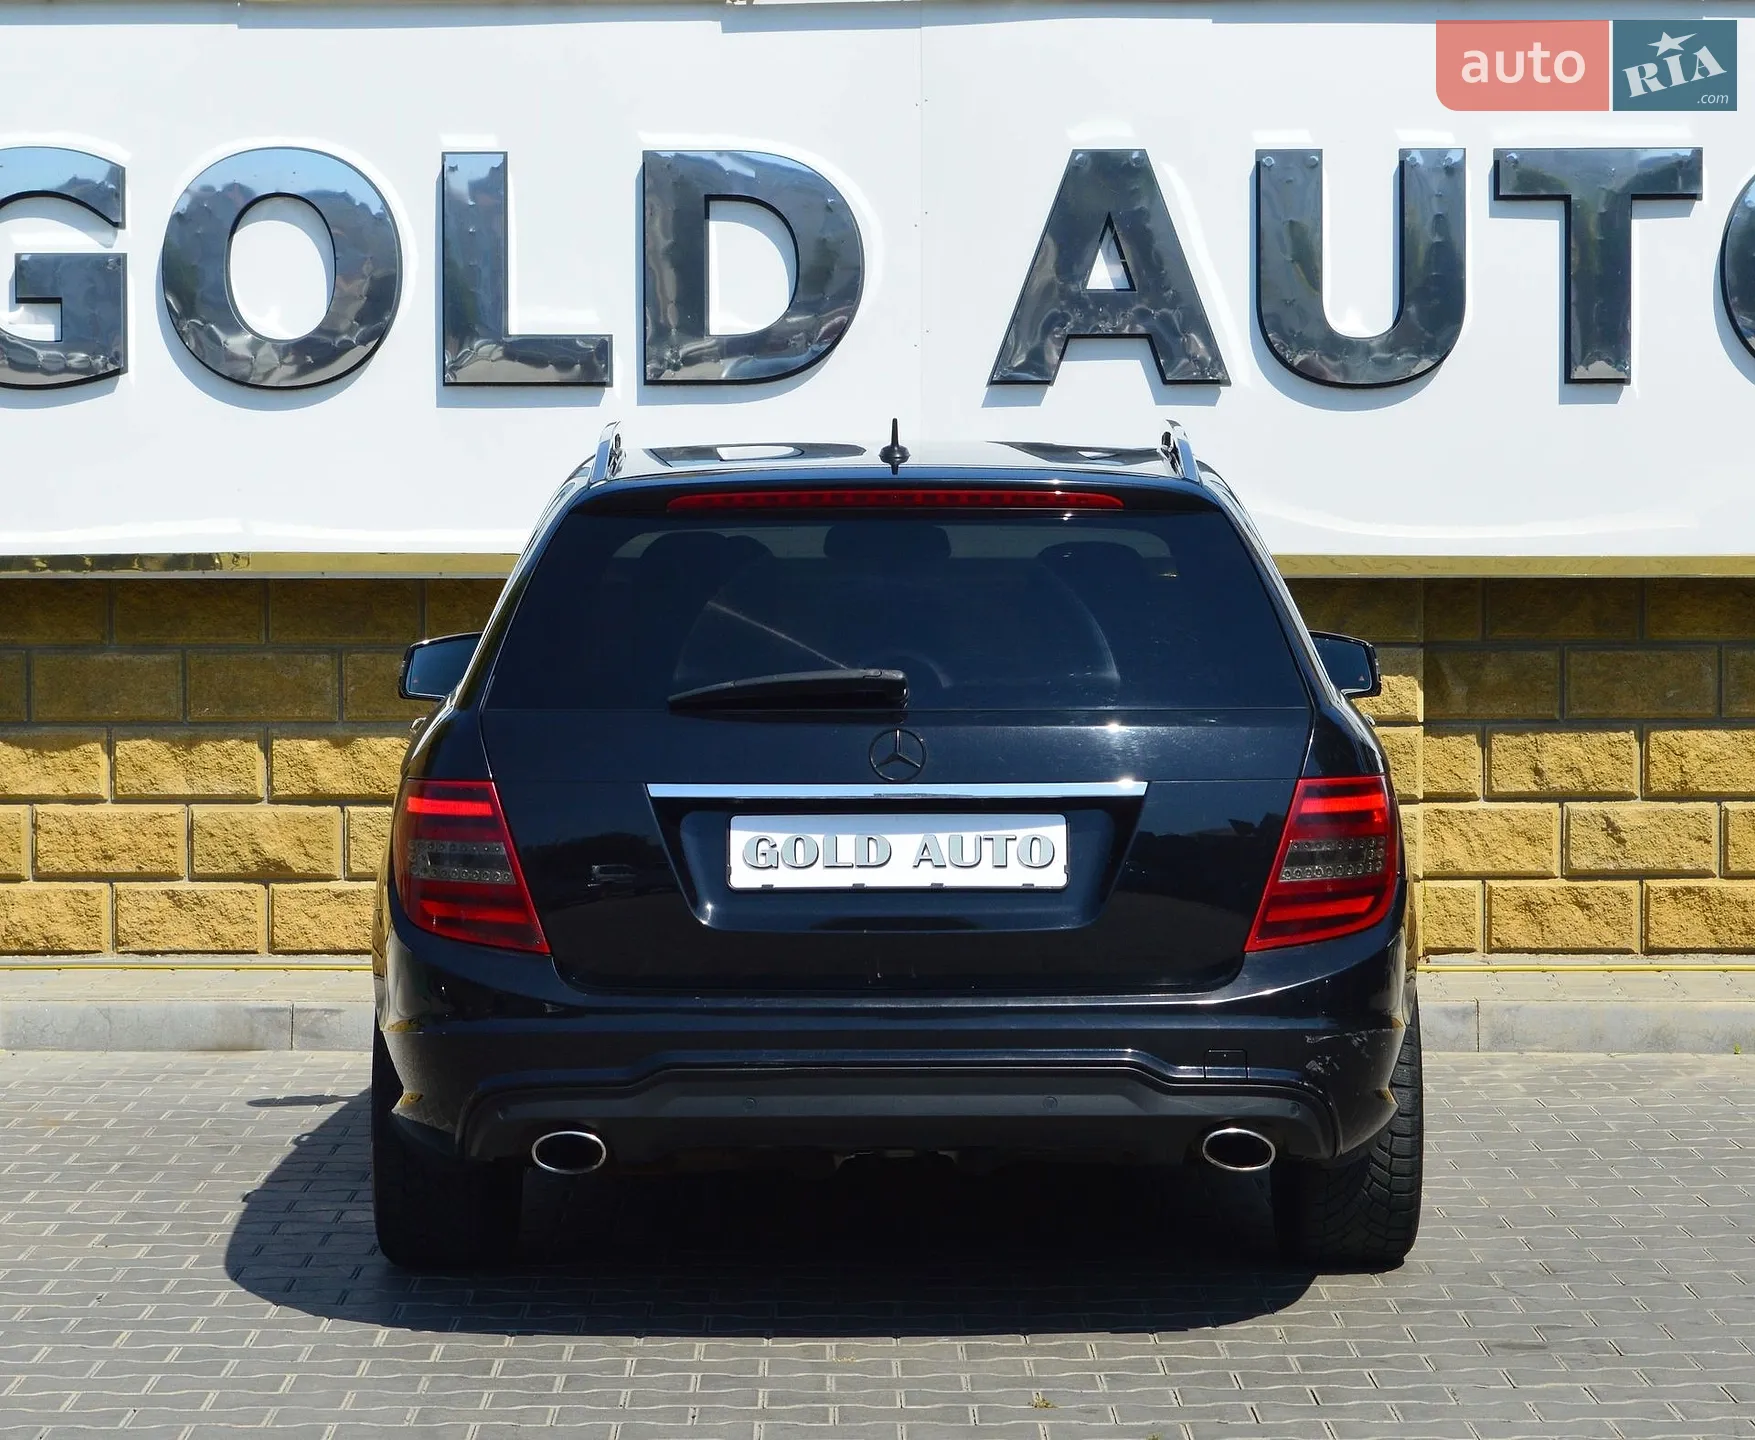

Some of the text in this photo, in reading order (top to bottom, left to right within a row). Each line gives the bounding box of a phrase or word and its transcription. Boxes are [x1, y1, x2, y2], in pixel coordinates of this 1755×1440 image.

[987, 147, 1755, 390] AUT
[742, 834, 1055, 869] GOLD AUTO
